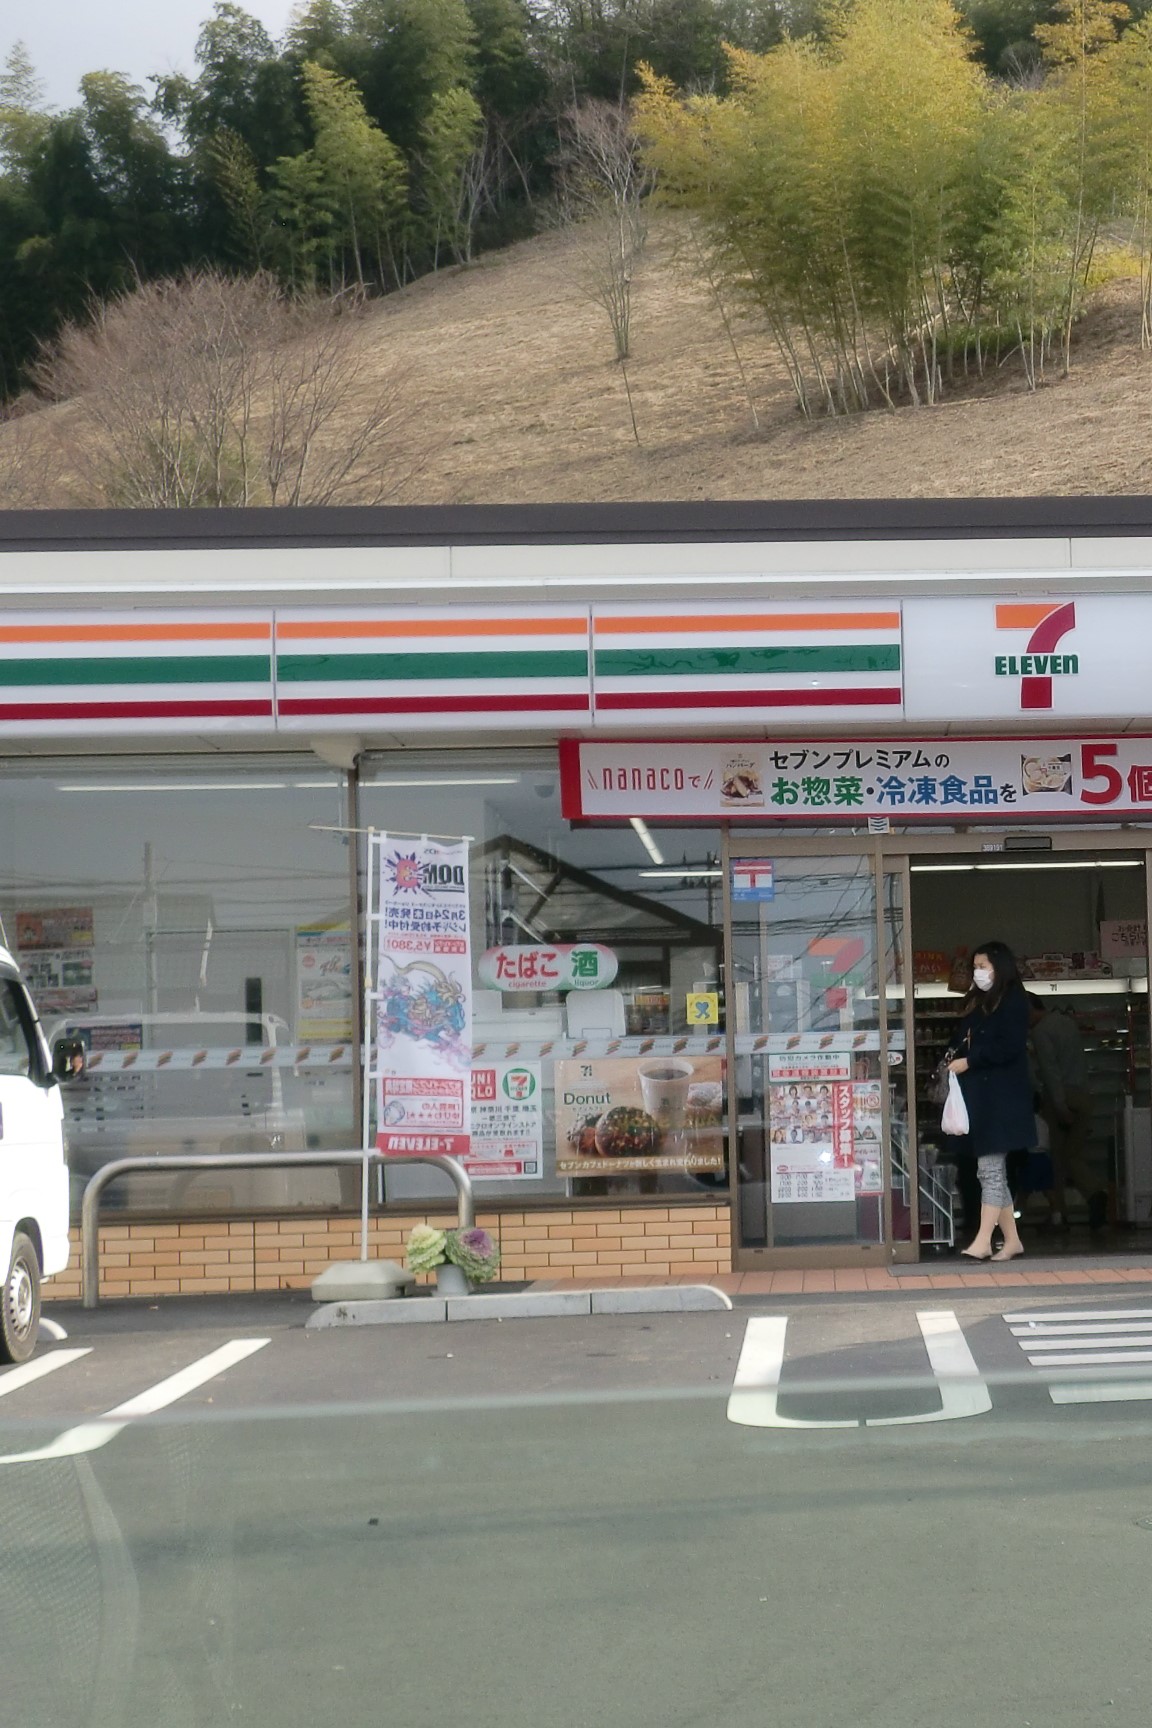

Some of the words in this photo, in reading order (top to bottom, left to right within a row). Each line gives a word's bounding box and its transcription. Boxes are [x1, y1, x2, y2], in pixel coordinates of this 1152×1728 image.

[769, 749, 950, 771] セブンプレミアムの
[602, 766, 701, 791] nanacoで
[770, 774, 1017, 807] お惣菜・冷凍食品を
[496, 951, 558, 979] たばこ
[571, 951, 598, 977] 酒
[508, 981, 547, 989] cigarette
[574, 978, 598, 987] liquor
[563, 1092, 611, 1105] Donut
